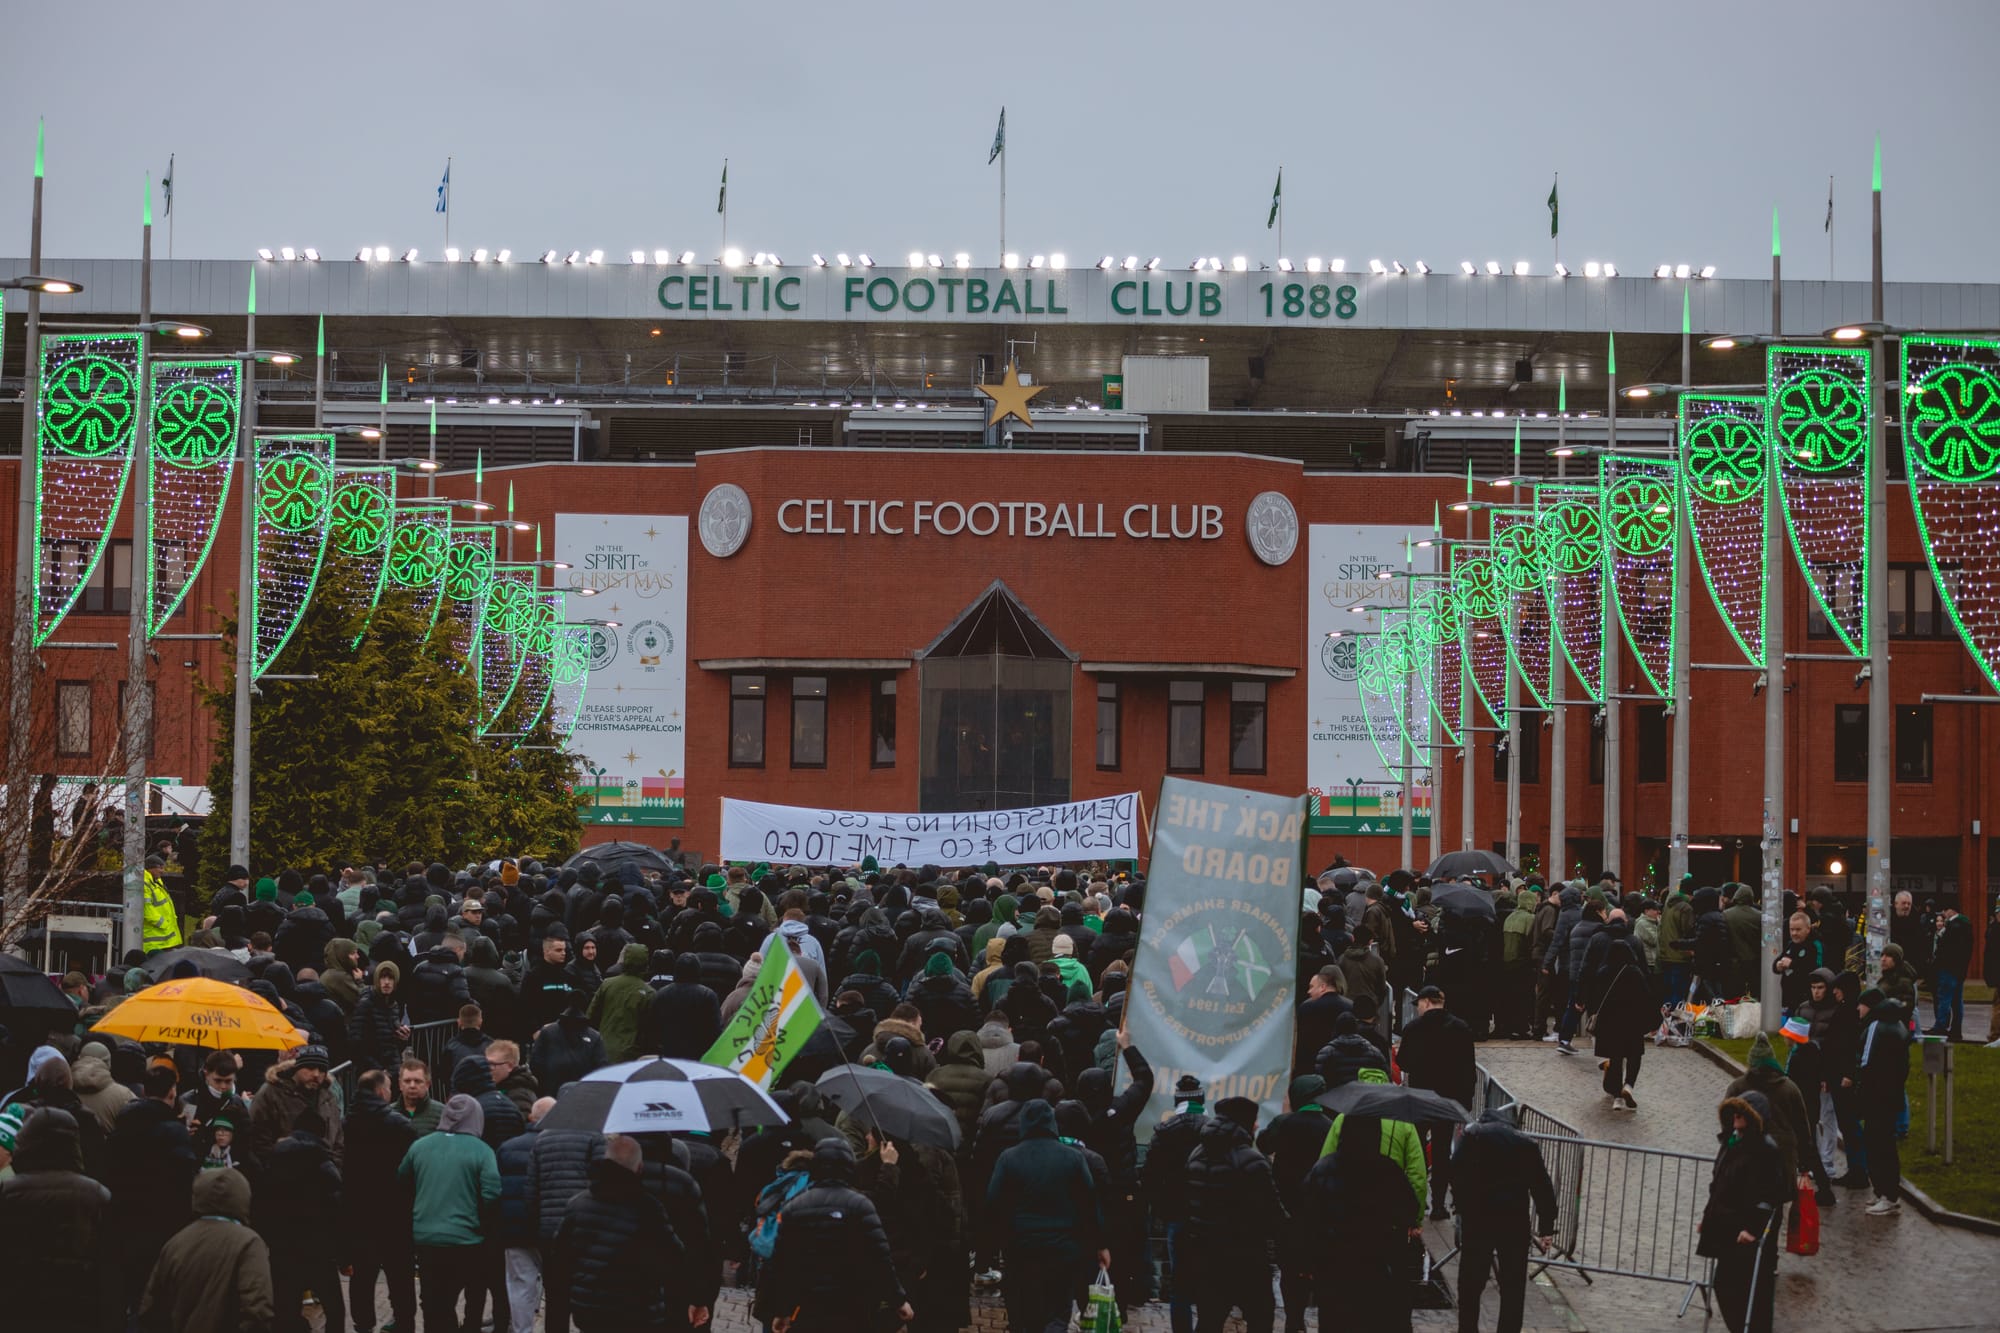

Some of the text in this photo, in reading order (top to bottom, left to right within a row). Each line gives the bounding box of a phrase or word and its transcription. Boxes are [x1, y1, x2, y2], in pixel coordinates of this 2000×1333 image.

[657, 275, 1358, 318] CELTIC FOOTBALL CLUB 1888
[777, 499, 904, 535] CELTIC
[914, 500, 1116, 538] FOOTBALL
[1122, 503, 1224, 540] CLUB
[584, 553, 649, 570] SPIRIT OF
[569, 571, 673, 597] CHRISTMAS
[586, 705, 654, 714] PLEASE SUPPORT
[575, 713, 665, 723] HIS YEAR'S APPEAL AT
[556, 723, 682, 733] CELICCHRISTMASAPPEAL.COM
[1329, 724, 1348, 732] THIS
[191, 1012, 241, 1028] OPEN
[633, 1111, 683, 1119] TRESPASS
